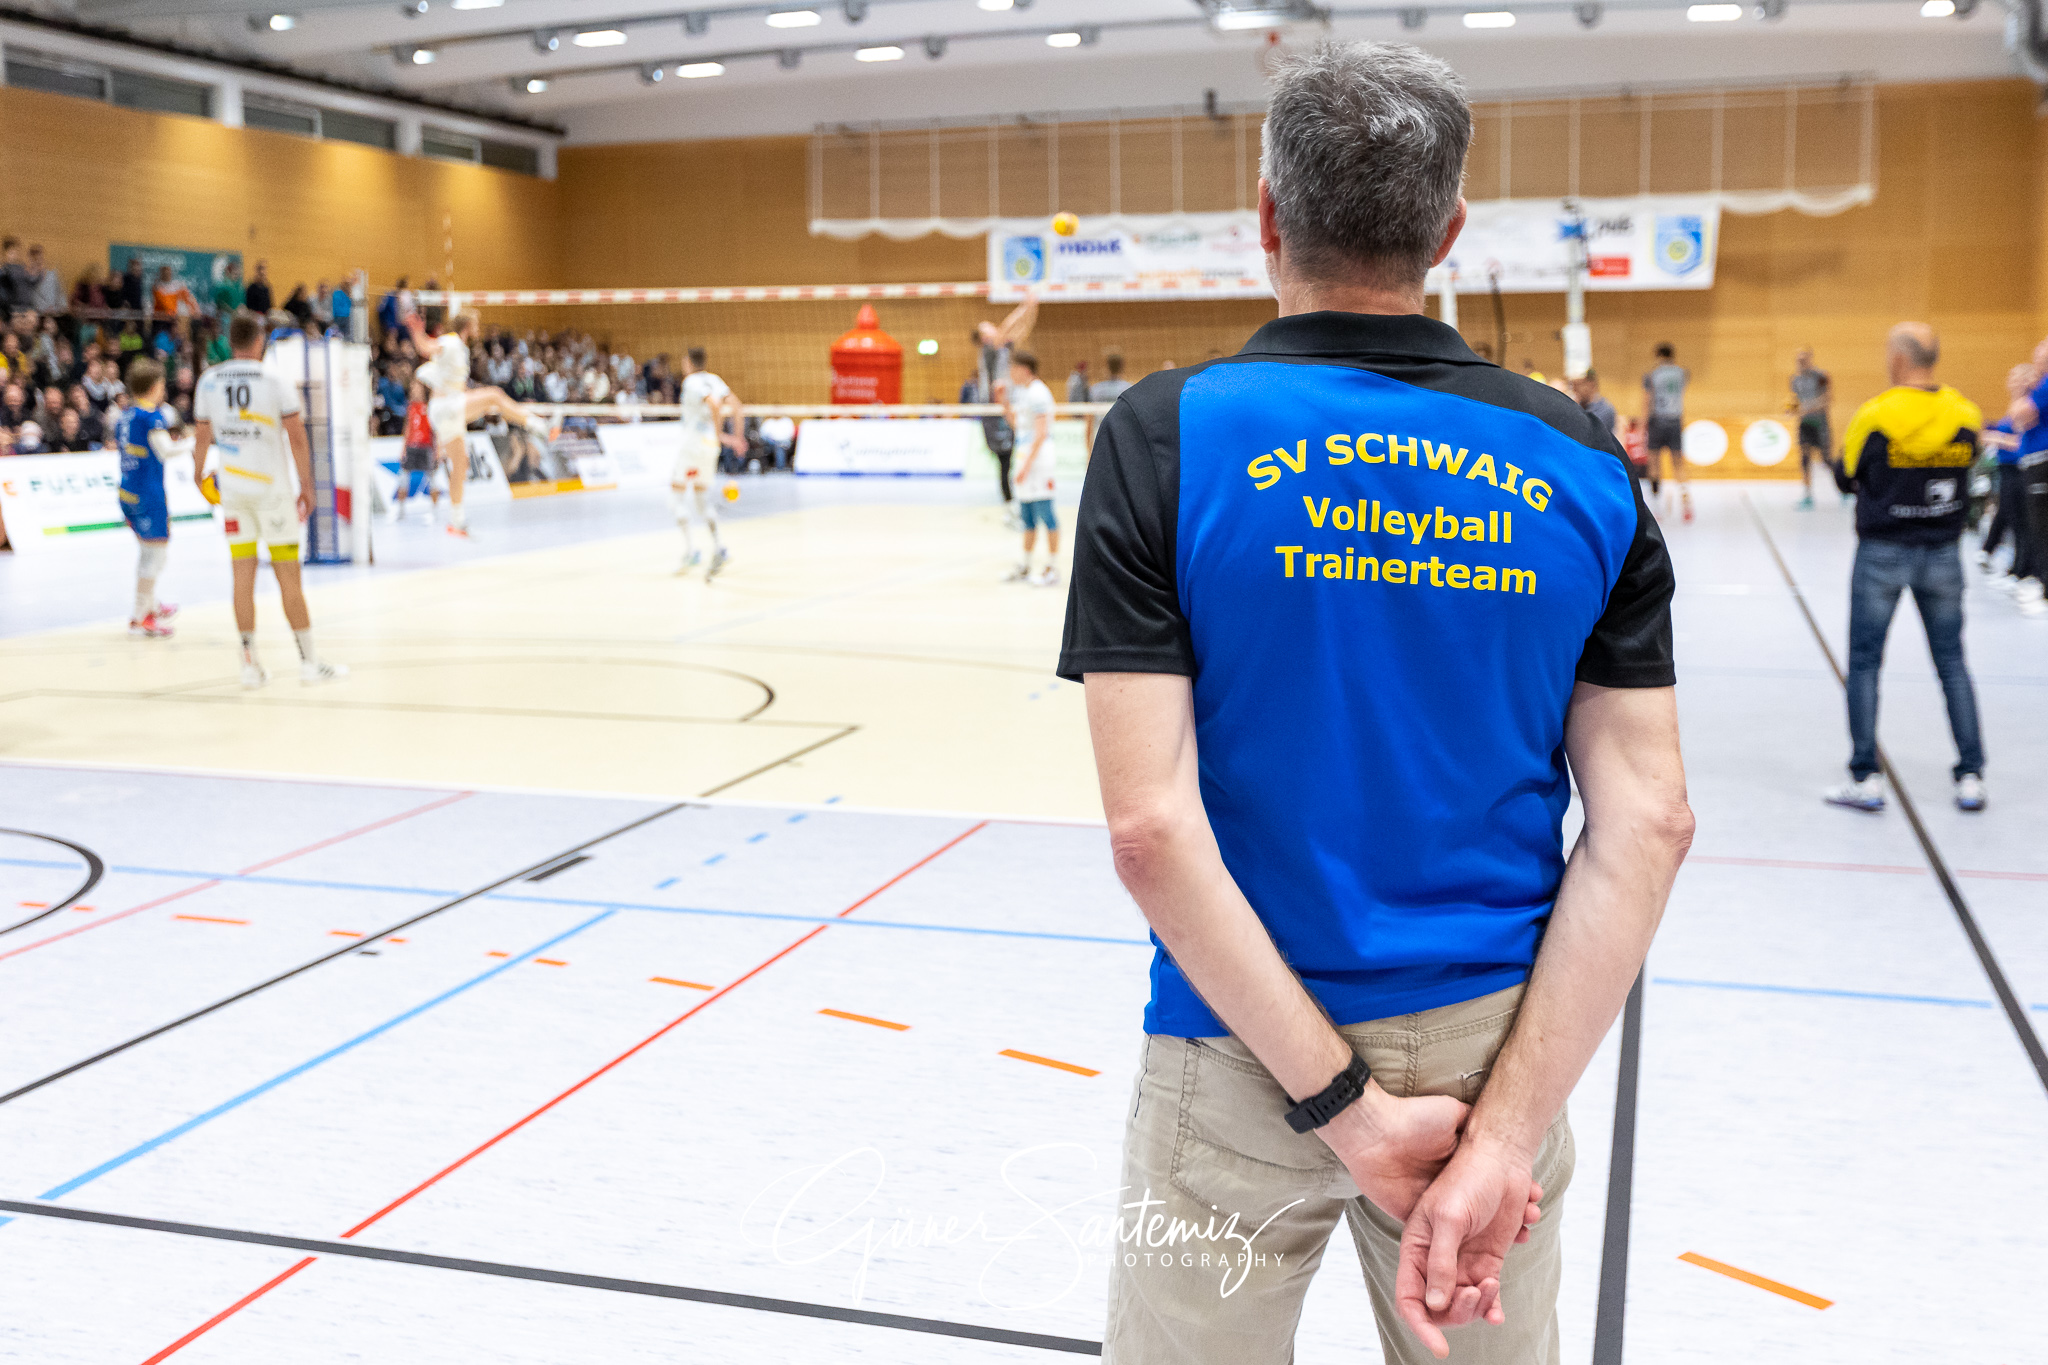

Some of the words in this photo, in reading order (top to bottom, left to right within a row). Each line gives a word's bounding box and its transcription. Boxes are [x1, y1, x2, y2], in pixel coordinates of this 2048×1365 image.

[225, 385, 250, 410] 10
[1247, 439, 1307, 490] SV
[1325, 433, 1553, 512] SCHWAIG
[1303, 496, 1511, 545] Volleyball
[1275, 546, 1537, 595] Trainerteam
